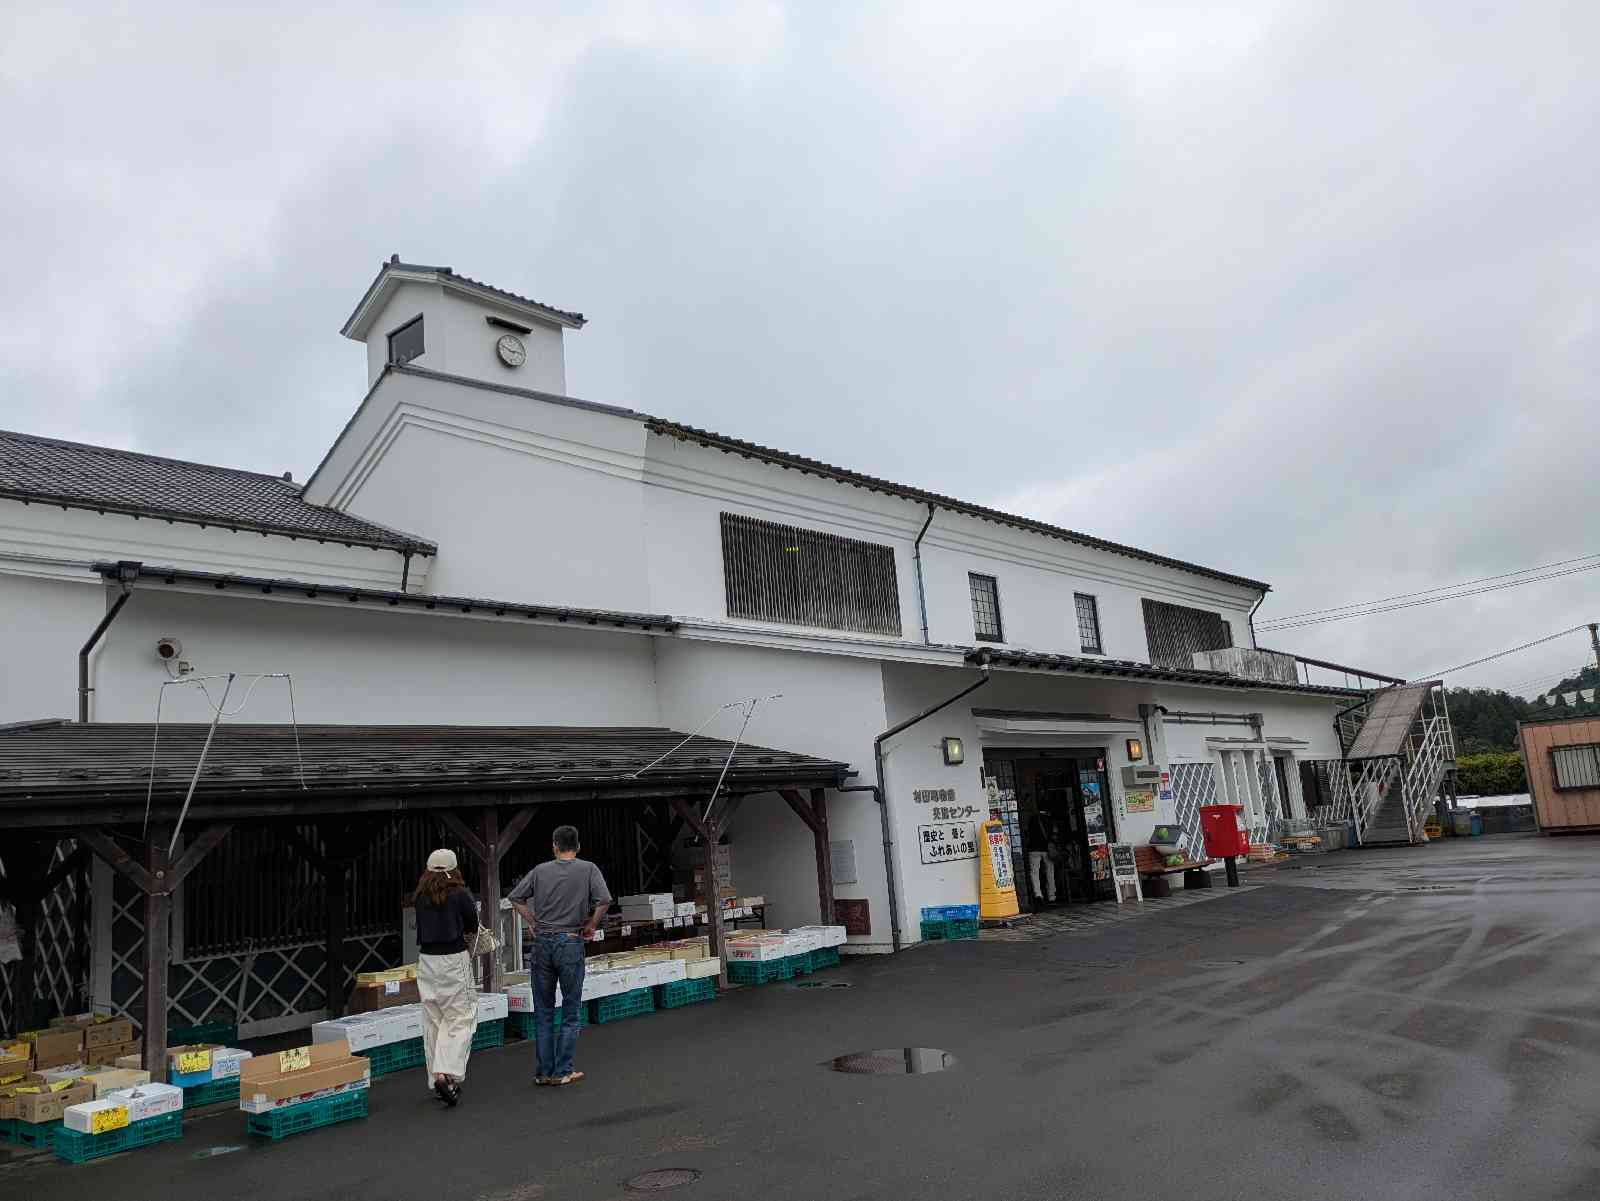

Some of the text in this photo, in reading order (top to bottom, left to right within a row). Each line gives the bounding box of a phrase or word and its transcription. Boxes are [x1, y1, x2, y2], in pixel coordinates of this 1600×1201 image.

[923, 830, 945, 842] 歴史と
[930, 841, 975, 857] ふれあいの里
